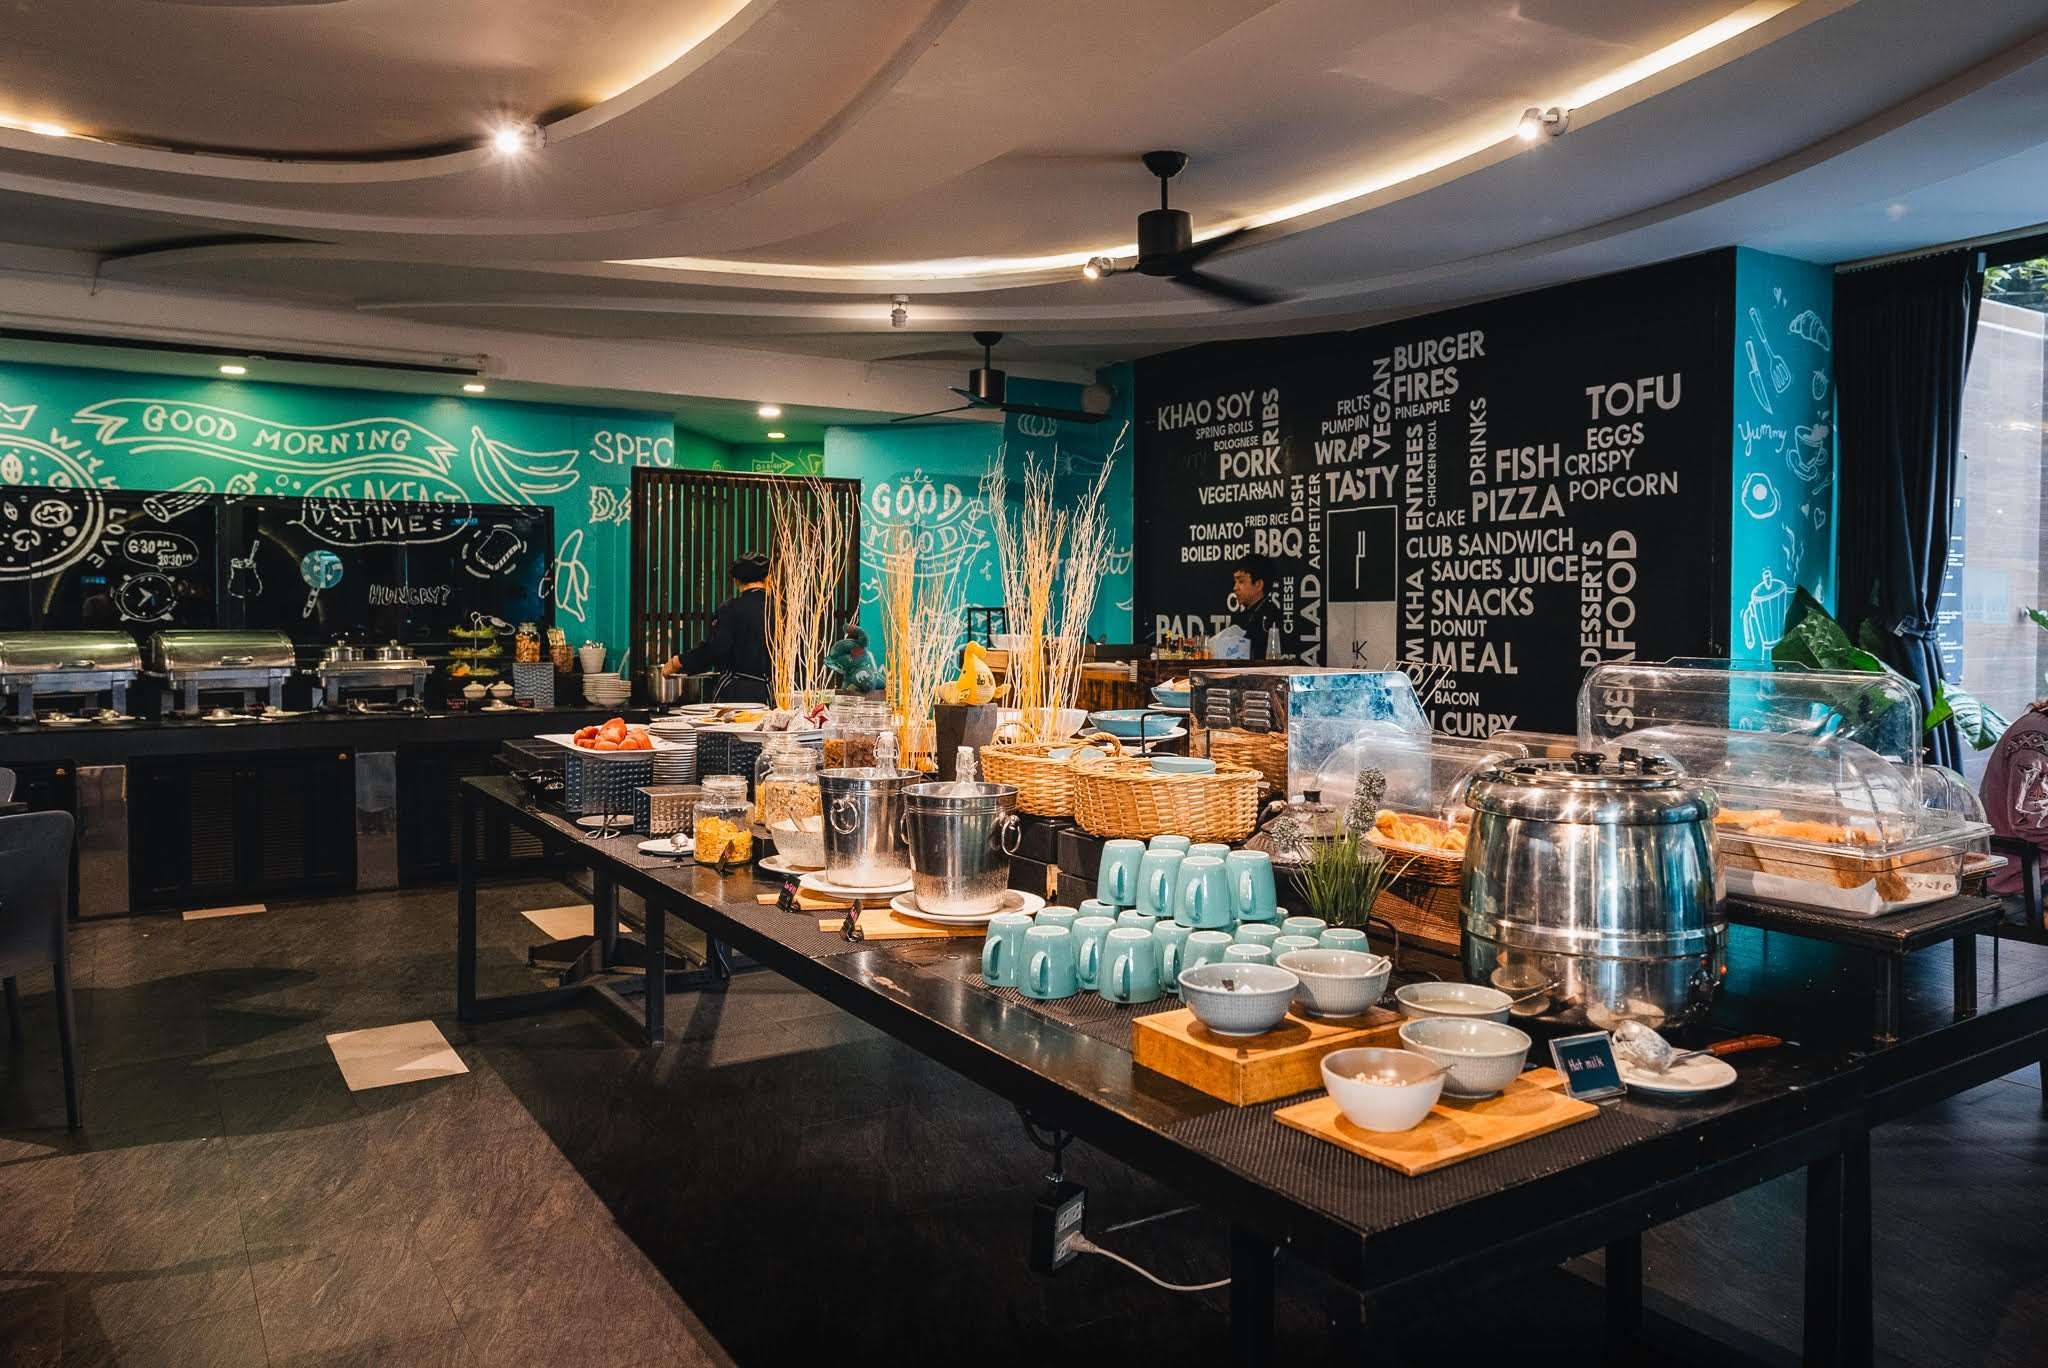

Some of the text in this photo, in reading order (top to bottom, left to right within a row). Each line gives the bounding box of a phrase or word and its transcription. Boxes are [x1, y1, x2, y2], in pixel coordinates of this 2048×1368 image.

[1394, 330, 1486, 372] BURGER
[1394, 366, 1460, 404] FIRES
[1585, 372, 1681, 420] TOFU
[1157, 390, 1255, 431] KHAO SOY
[1262, 387, 1279, 446] RIBS
[1373, 356, 1391, 460] VEGAN
[1395, 399, 1450, 420] PINEAPPLE
[143, 404, 411, 455] GOOD MORNING
[1195, 420, 1254, 440] SPRING ROLLS
[1213, 436, 1259, 451] BOLOGNESE
[1470, 396, 1487, 486] DRINKS
[1586, 422, 1645, 450] EGGS
[1219, 446, 1281, 480] PORK
[1314, 434, 1371, 465] WRAP
[1427, 420, 1437, 508] CHICKEN ROLL
[1496, 442, 1560, 483] FISH
[1564, 448, 1635, 475] CRISPY
[1198, 479, 1284, 505] VEGETARIAN
[1325, 464, 1400, 503] TASTY
[1406, 423, 1423, 530] ENTREES
[1569, 471, 1678, 502] POPCORN
[872, 483, 962, 521] GOOD
[1291, 474, 1304, 522] DISH
[1472, 484, 1566, 523] PIZZA
[339, 516, 427, 540] TIME
[1189, 522, 1244, 541] TOMATO
[1245, 513, 1289, 528] FRIED RICE
[1309, 472, 1321, 569] APPETIZER
[1426, 509, 1466, 528] CAKE
[867, 525, 959, 554] MOOD
[1181, 544, 1250, 562] BOILED RICE
[1254, 527, 1303, 559] BBQ
[1406, 527, 1574, 559] CLUB SANDWICH
[1431, 555, 1579, 584] SAUCES JUICE
[1283, 576, 1294, 634] CHEESE
[1431, 586, 1535, 617] SNACKS
[1581, 540, 1603, 667] DESSERTS
[1156, 614, 1205, 645] PAD
[1300, 574, 1321, 667] ALAD
[1406, 568, 1424, 687] OM KHA
[1430, 619, 1488, 637] DONUT
[1432, 641, 1518, 675] MEAL
[1434, 690, 1479, 707] BACON
[1441, 711, 1518, 738] CURRY
[1567, 1055, 1605, 1072] Hot milk
